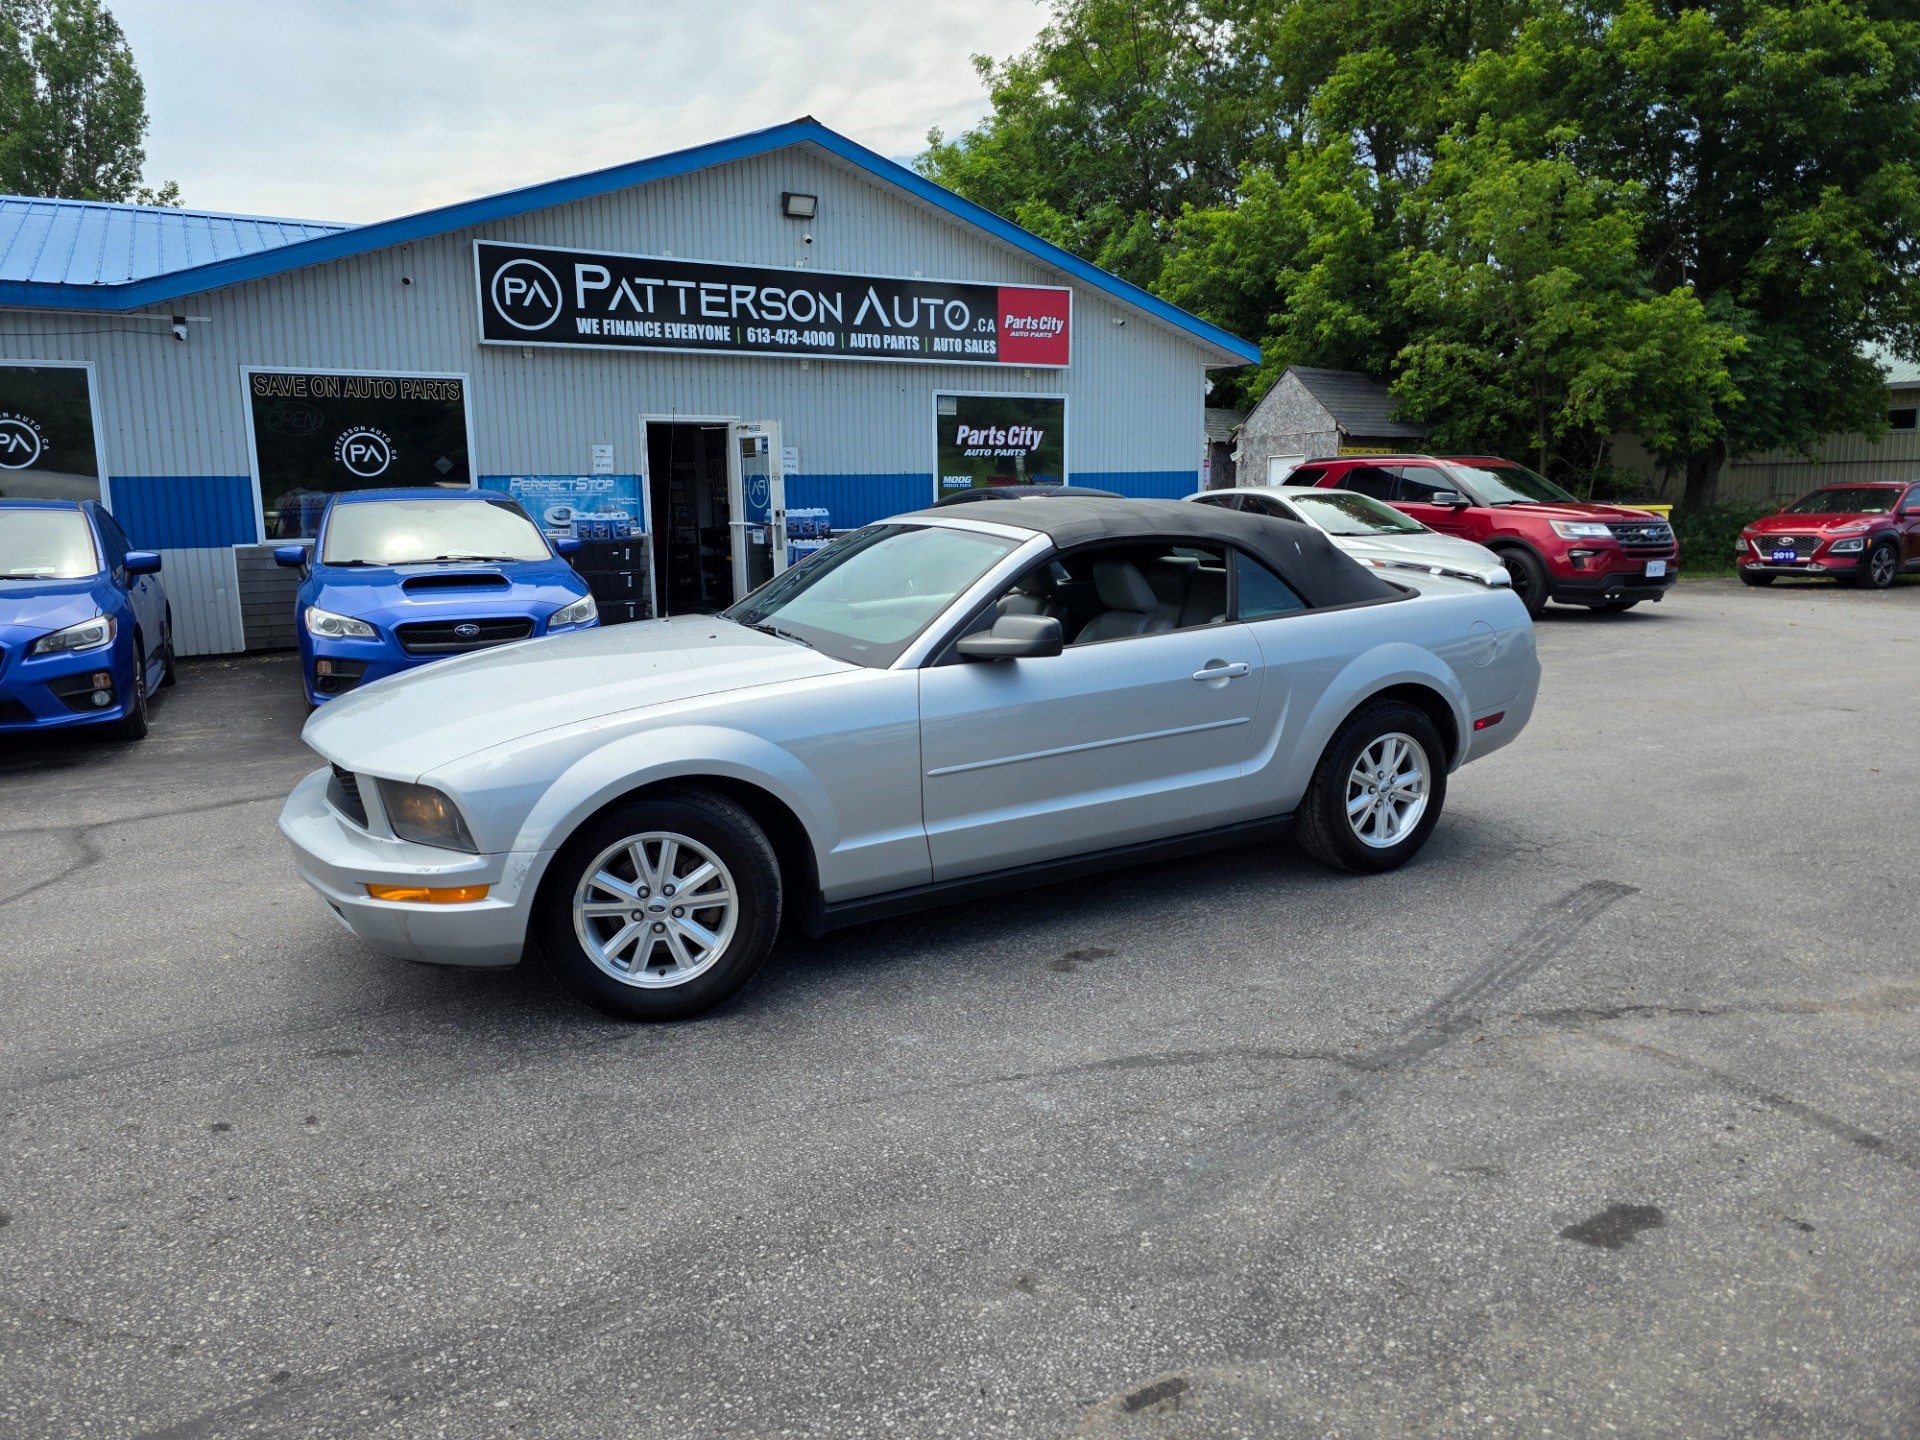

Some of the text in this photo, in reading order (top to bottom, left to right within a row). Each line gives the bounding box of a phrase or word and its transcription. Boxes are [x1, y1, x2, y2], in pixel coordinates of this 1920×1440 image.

[574, 263, 843, 325] PATTERSON
[576, 317, 997, 355] WE FINANCE EVERYONE 613-473-4000 AUTO PARTS AUTO SALES
[254, 374, 461, 400] SAVE ON AUTO PARTS
[14, 413, 41, 431] AUTO
[267, 411, 318, 428] OPEN
[370, 427, 391, 443] AUTO
[350, 444, 384, 463] PA
[964, 449, 1027, 457] AUTO PARTS
[942, 476, 972, 484] MOOG
[1773, 552, 1795, 560] 2019
